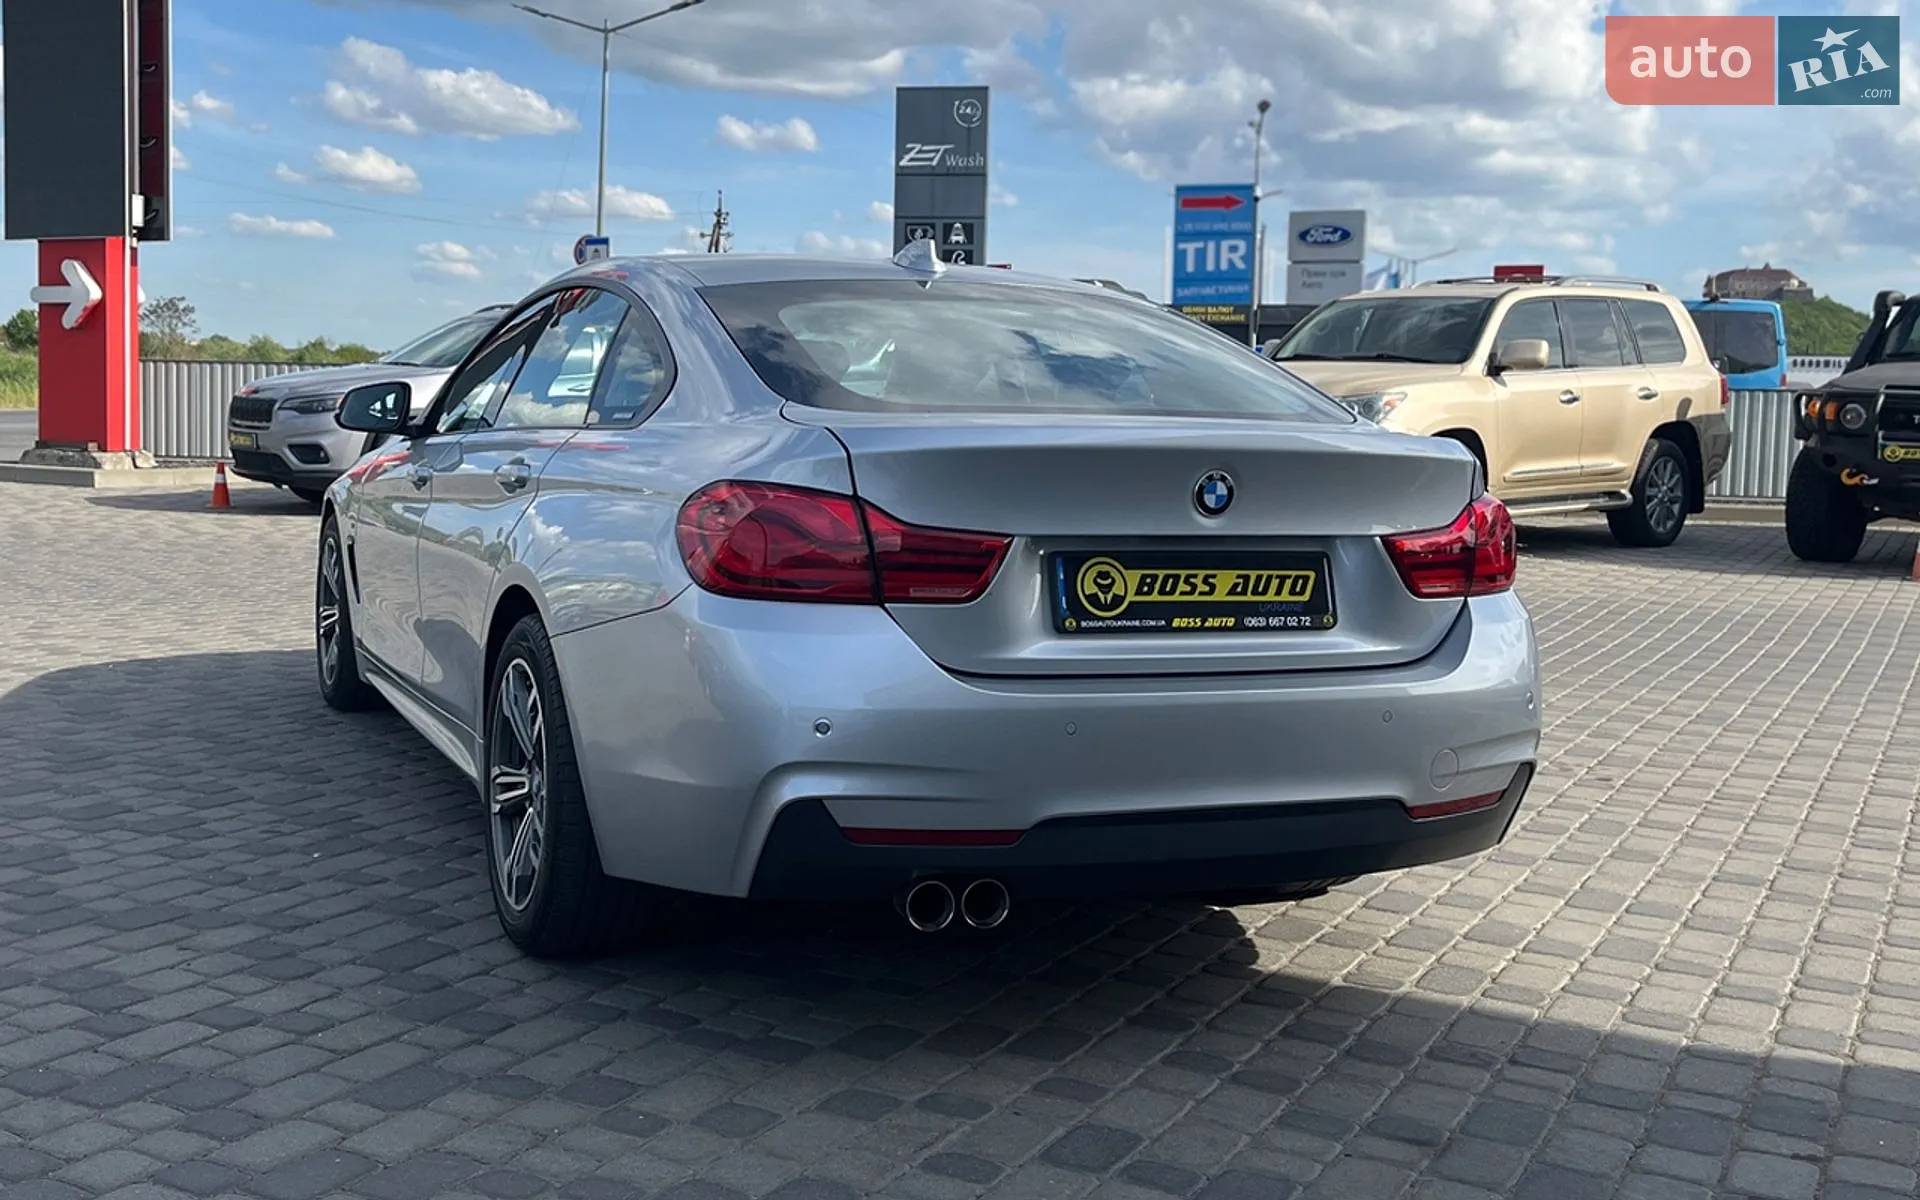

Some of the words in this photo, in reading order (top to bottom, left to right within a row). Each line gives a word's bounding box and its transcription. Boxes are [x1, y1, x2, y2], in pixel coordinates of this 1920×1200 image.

[899, 143, 955, 166] ZET
[945, 152, 984, 167] Wash
[1305, 227, 1342, 242] Ford
[1177, 239, 1246, 273] TIR
[1134, 573, 1218, 597] BOSS
[1226, 573, 1312, 597] AUTO
[1171, 617, 1202, 628] BOSS
[1204, 617, 1236, 627] AUTO
[1268, 616, 1285, 627] 667
[1286, 616, 1299, 627] 02
[1299, 616, 1312, 627] 72
